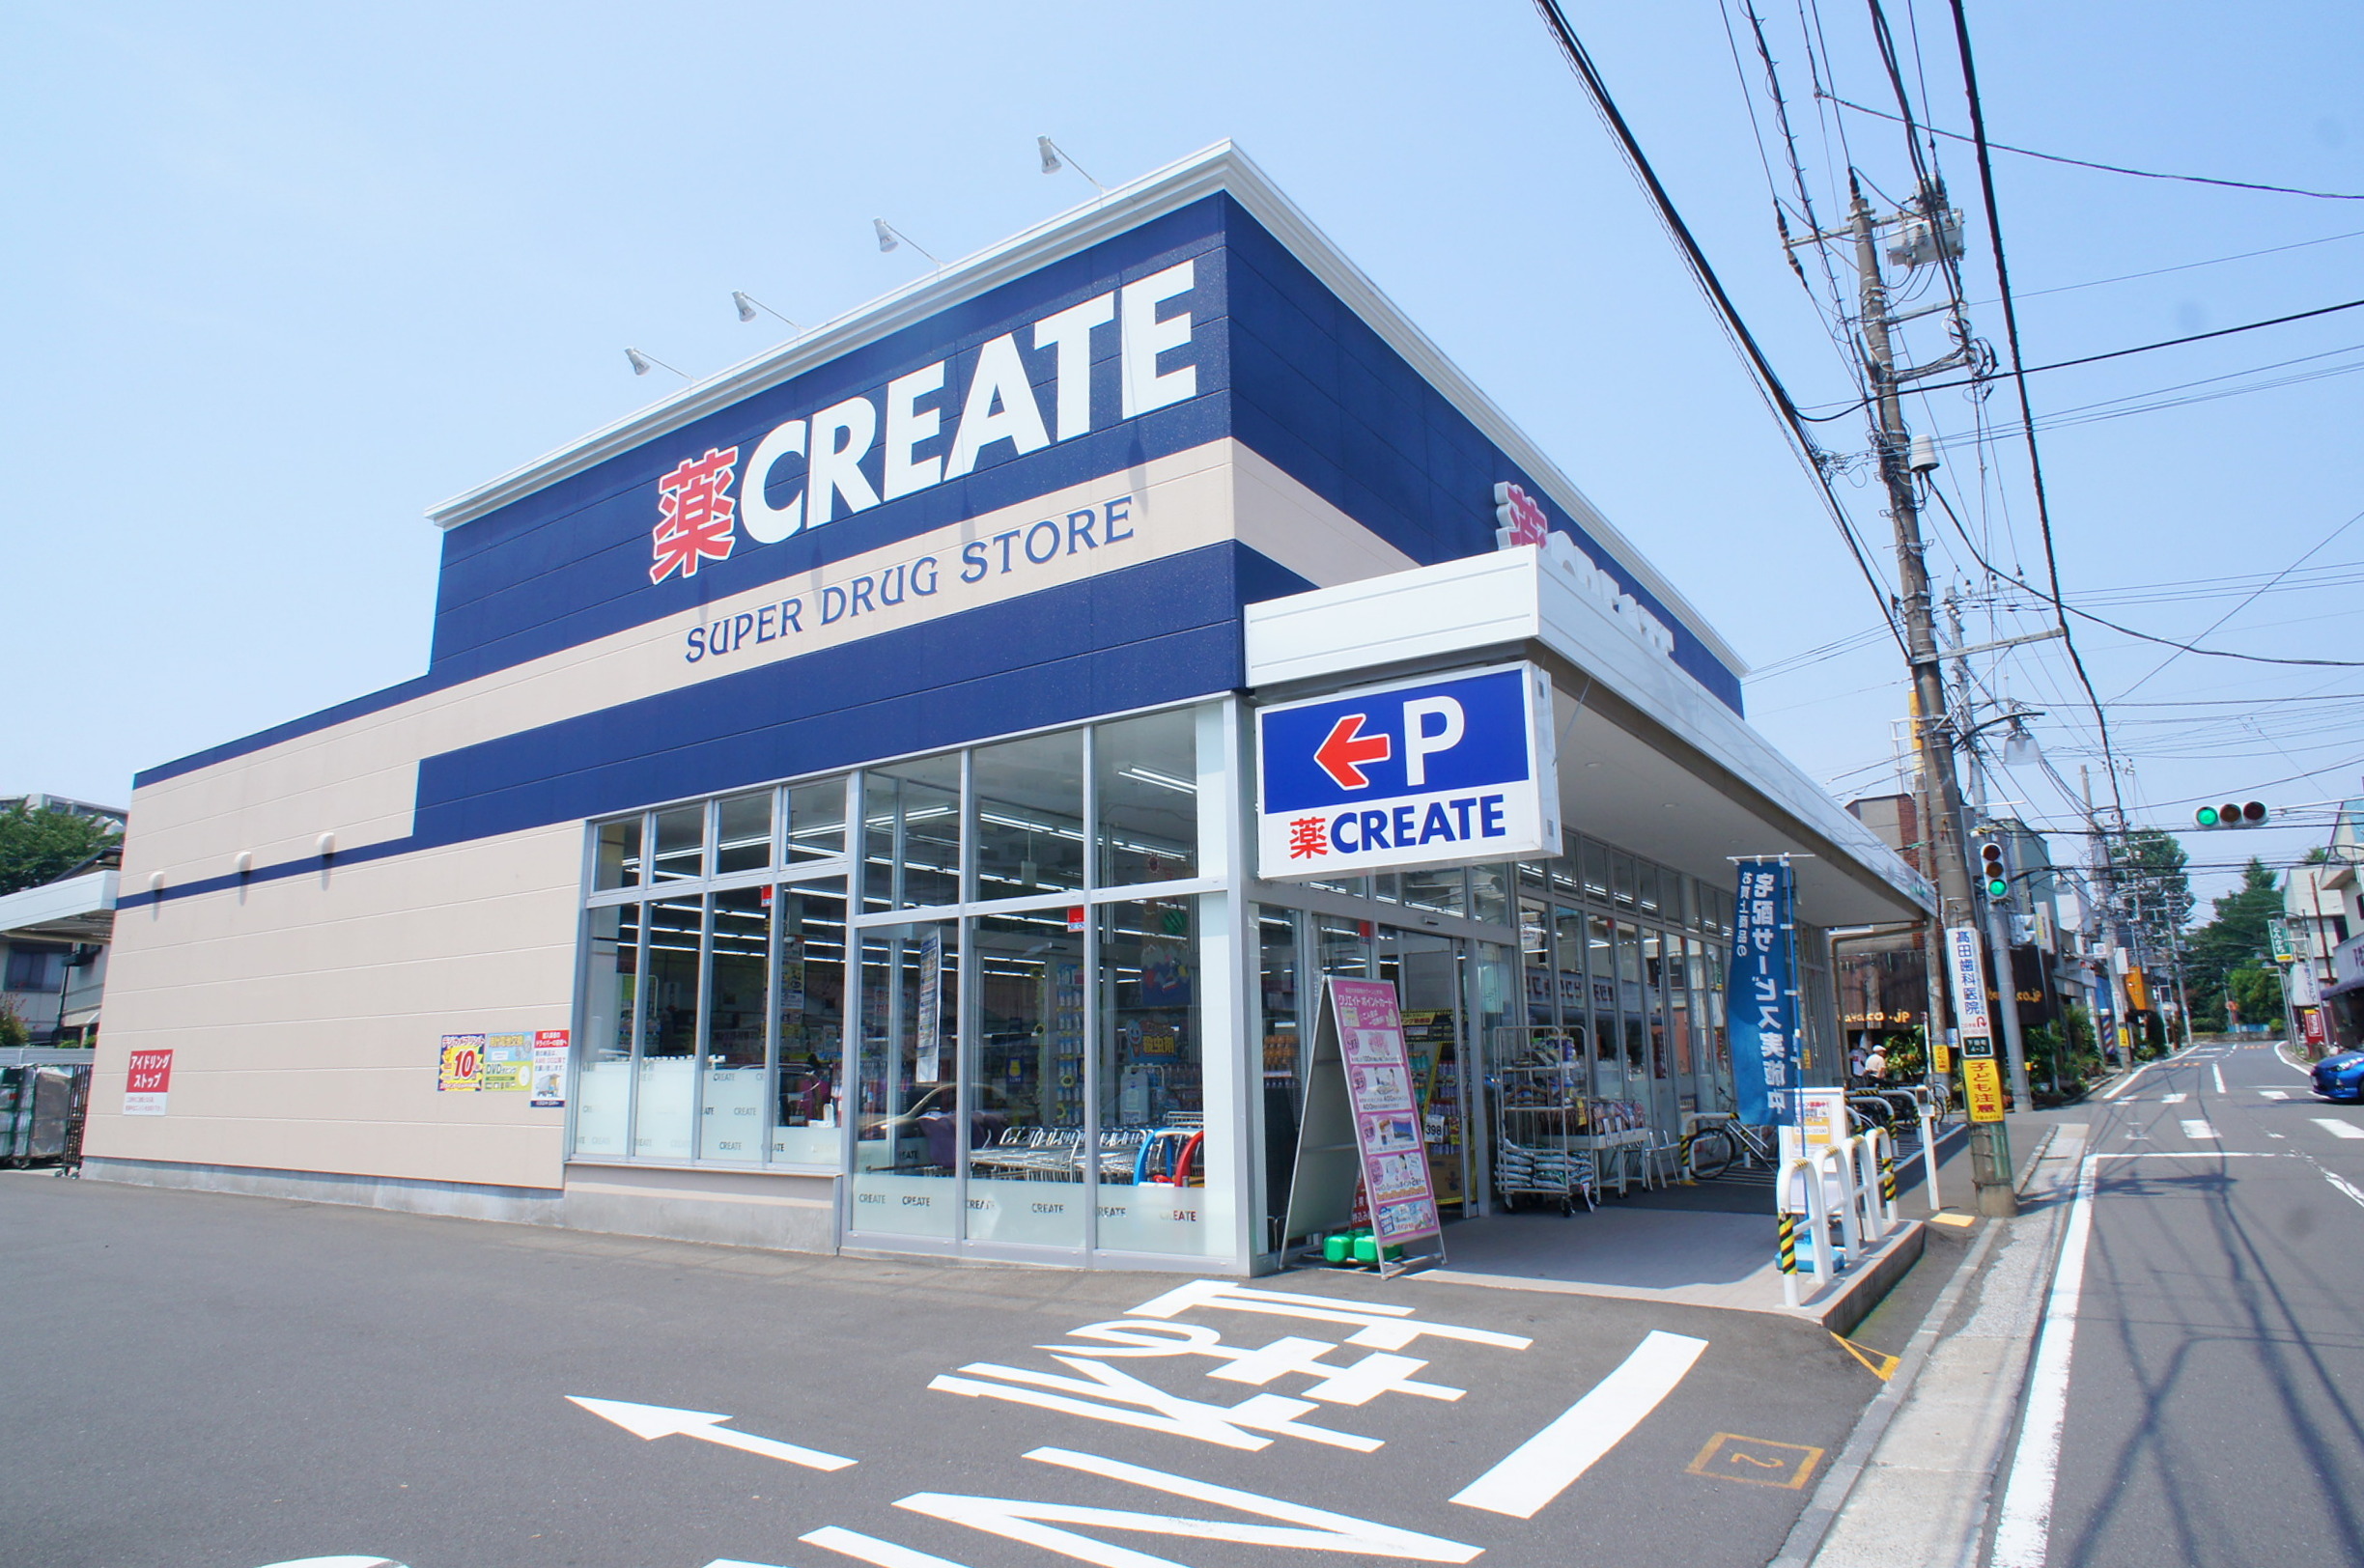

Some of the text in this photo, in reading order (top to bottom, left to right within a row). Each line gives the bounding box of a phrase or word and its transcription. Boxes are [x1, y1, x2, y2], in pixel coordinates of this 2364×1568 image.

[741, 260, 1197, 544] CREATE
[685, 495, 1134, 663] SUPER DRUG STORE
[1403, 695, 1465, 786] P
[1330, 794, 1506, 853] CREATE
[1142, 1035, 1174, 1054] 殺虫剤
[130, 1053, 171, 1070] アイドリング
[454, 1049, 476, 1079] 10
[133, 1072, 161, 1088] ストップ
[713, 1073, 735, 1081] CREATE
[1970, 1062, 1996, 1113] 子ども注意
[734, 1107, 757, 1116] CREATE
[1425, 1124, 1442, 1135] 398
[718, 1141, 742, 1151] CREATE
[858, 1193, 886, 1205] CREATE
[902, 1195, 931, 1207] CREATE
[1032, 1203, 1064, 1214] CREATE
[927, 1279, 1534, 1452] 止まれ
